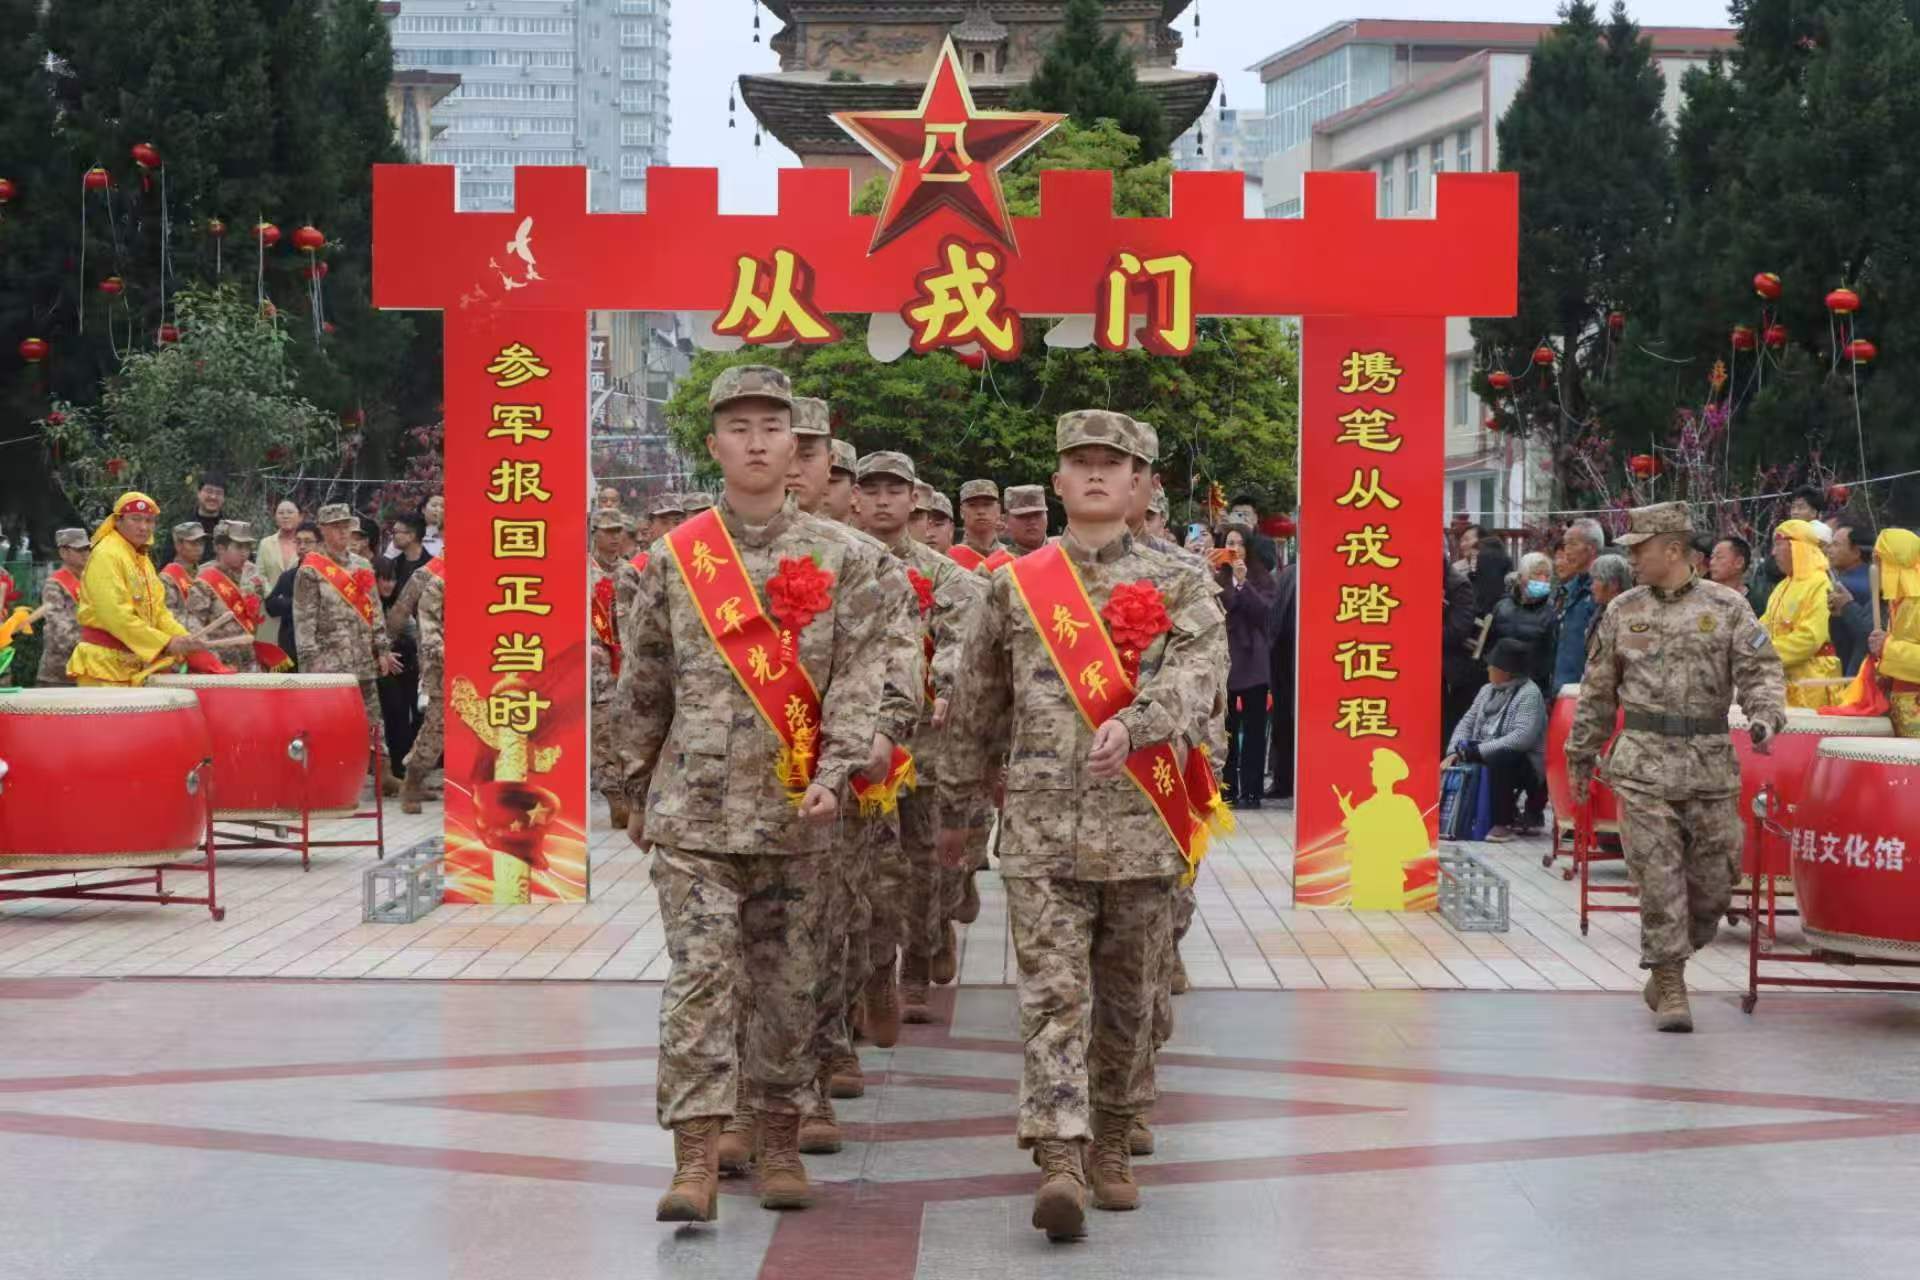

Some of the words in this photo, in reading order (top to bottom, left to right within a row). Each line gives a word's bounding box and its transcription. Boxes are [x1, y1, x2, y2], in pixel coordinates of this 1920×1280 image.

[919, 121, 973, 183] 八一
[716, 243, 1194, 352] 从戎门
[486, 342, 552, 734] 参军报国正当时
[1334, 350, 1403, 739] 携笔从戎踏征程
[1052, 603, 1175, 797] 参军荣
